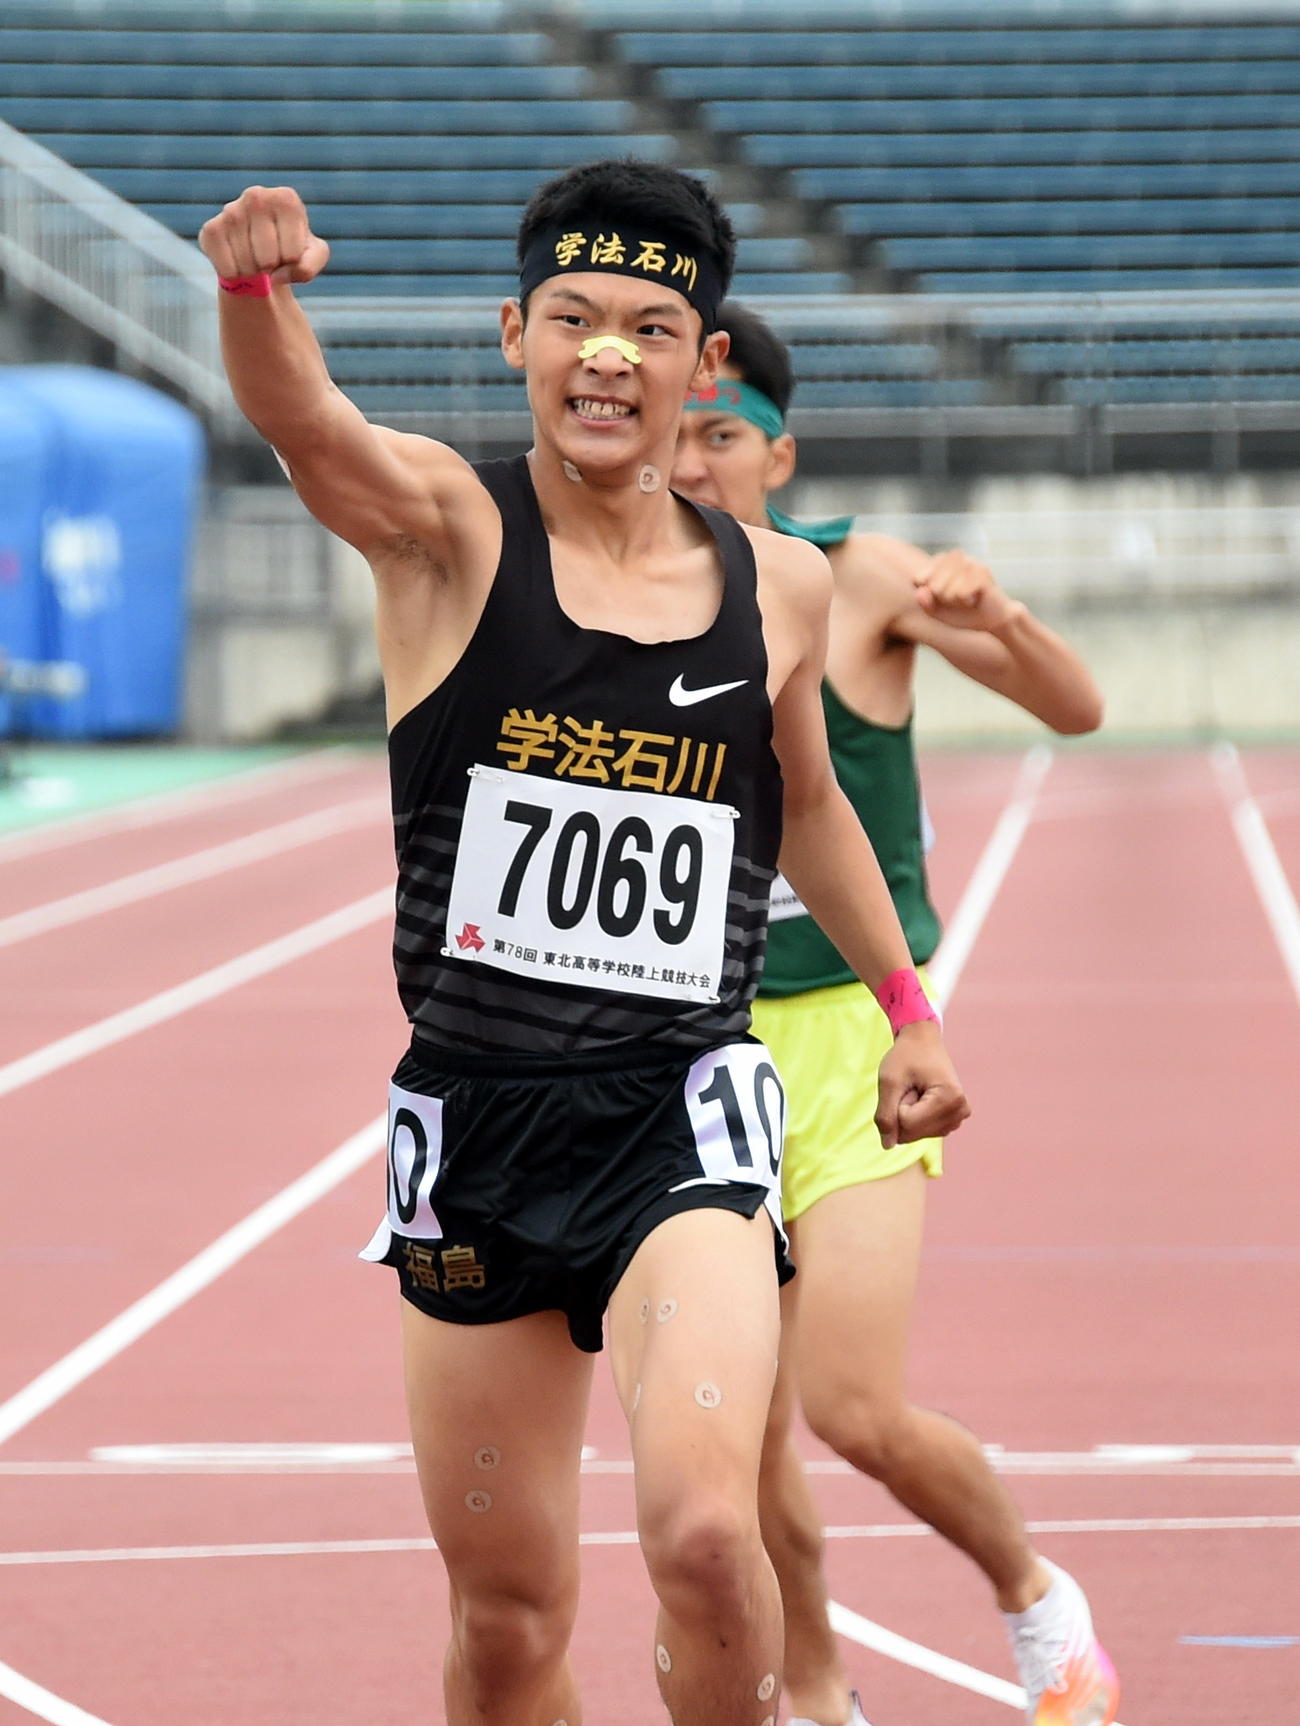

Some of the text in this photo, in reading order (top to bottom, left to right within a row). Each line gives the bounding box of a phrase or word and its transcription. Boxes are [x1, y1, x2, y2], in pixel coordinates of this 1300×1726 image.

[554, 231, 698, 291] 学法石川
[496, 708, 727, 801] 学法石川
[497, 800, 703, 945] 7069
[493, 938, 711, 988] 第78回 東北高等学校陸上競技大会
[698, 1061, 785, 1177] 10
[402, 1243, 486, 1293] 福島
